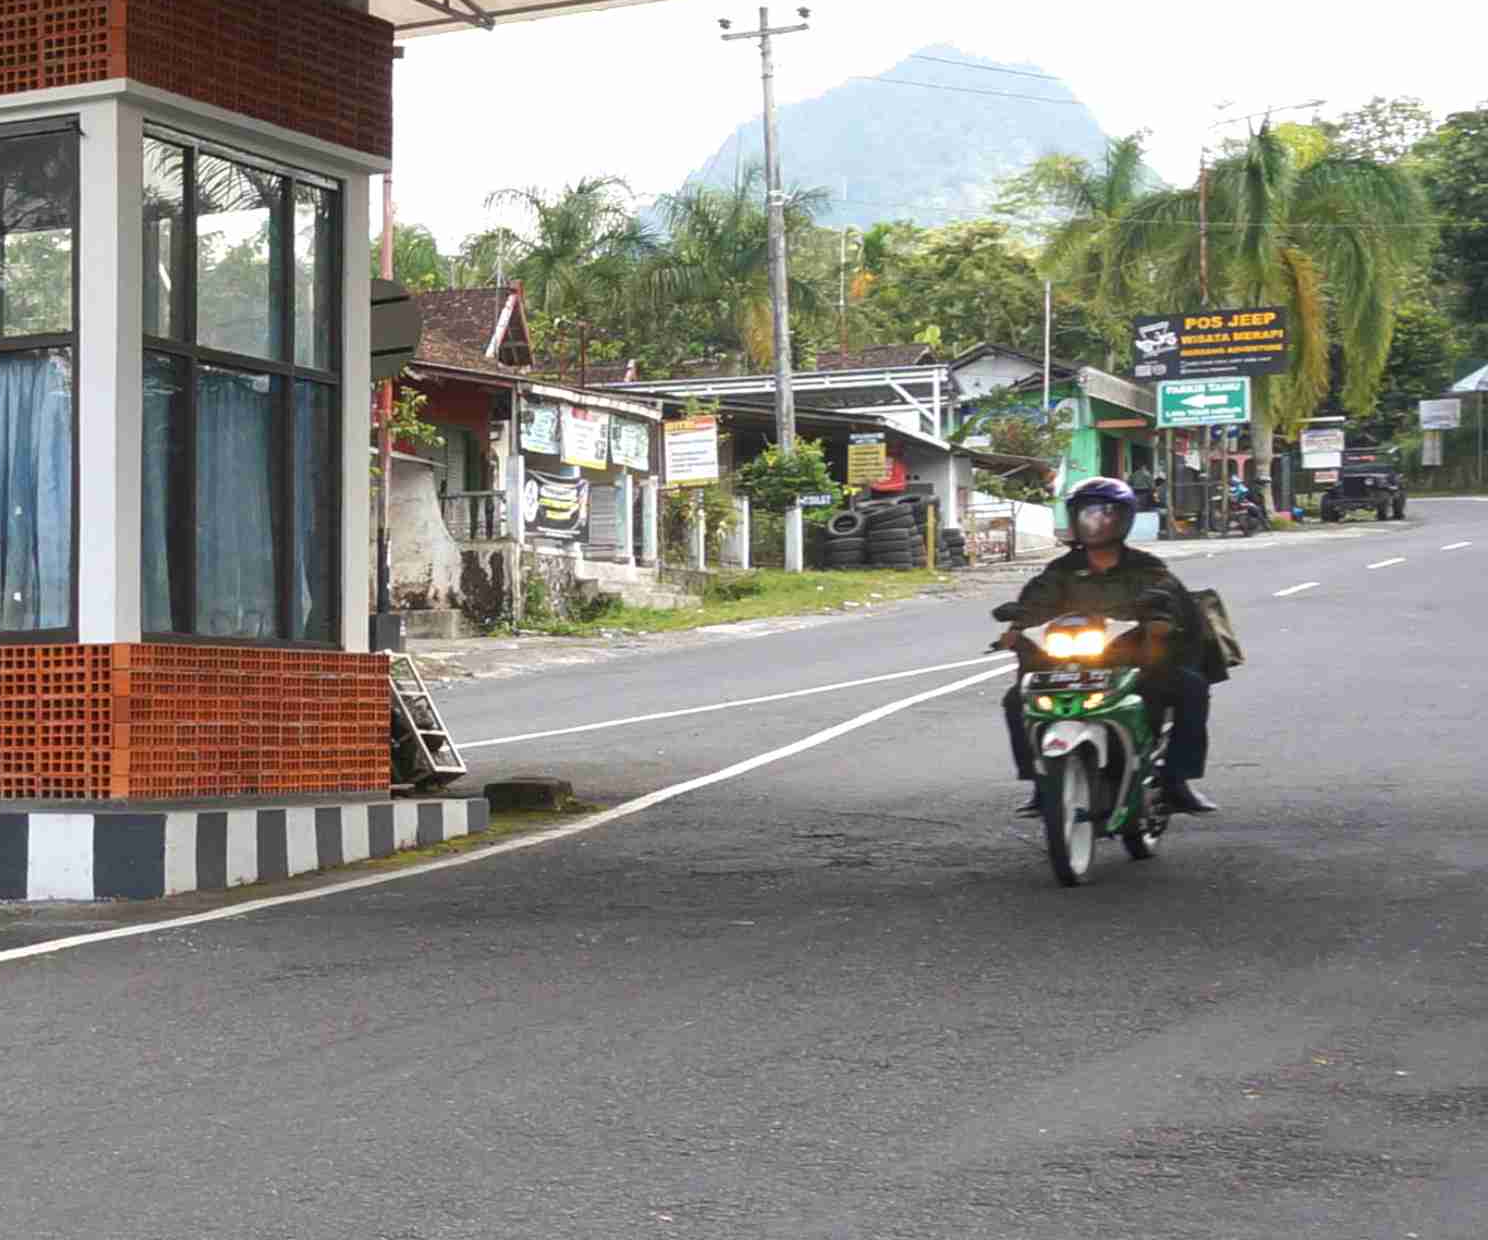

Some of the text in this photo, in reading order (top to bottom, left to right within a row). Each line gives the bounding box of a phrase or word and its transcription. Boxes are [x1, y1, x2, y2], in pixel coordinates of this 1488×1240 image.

[1184, 312, 1277, 330] POS JEEP
[1180, 329, 1284, 344] WISATA MERAPI
